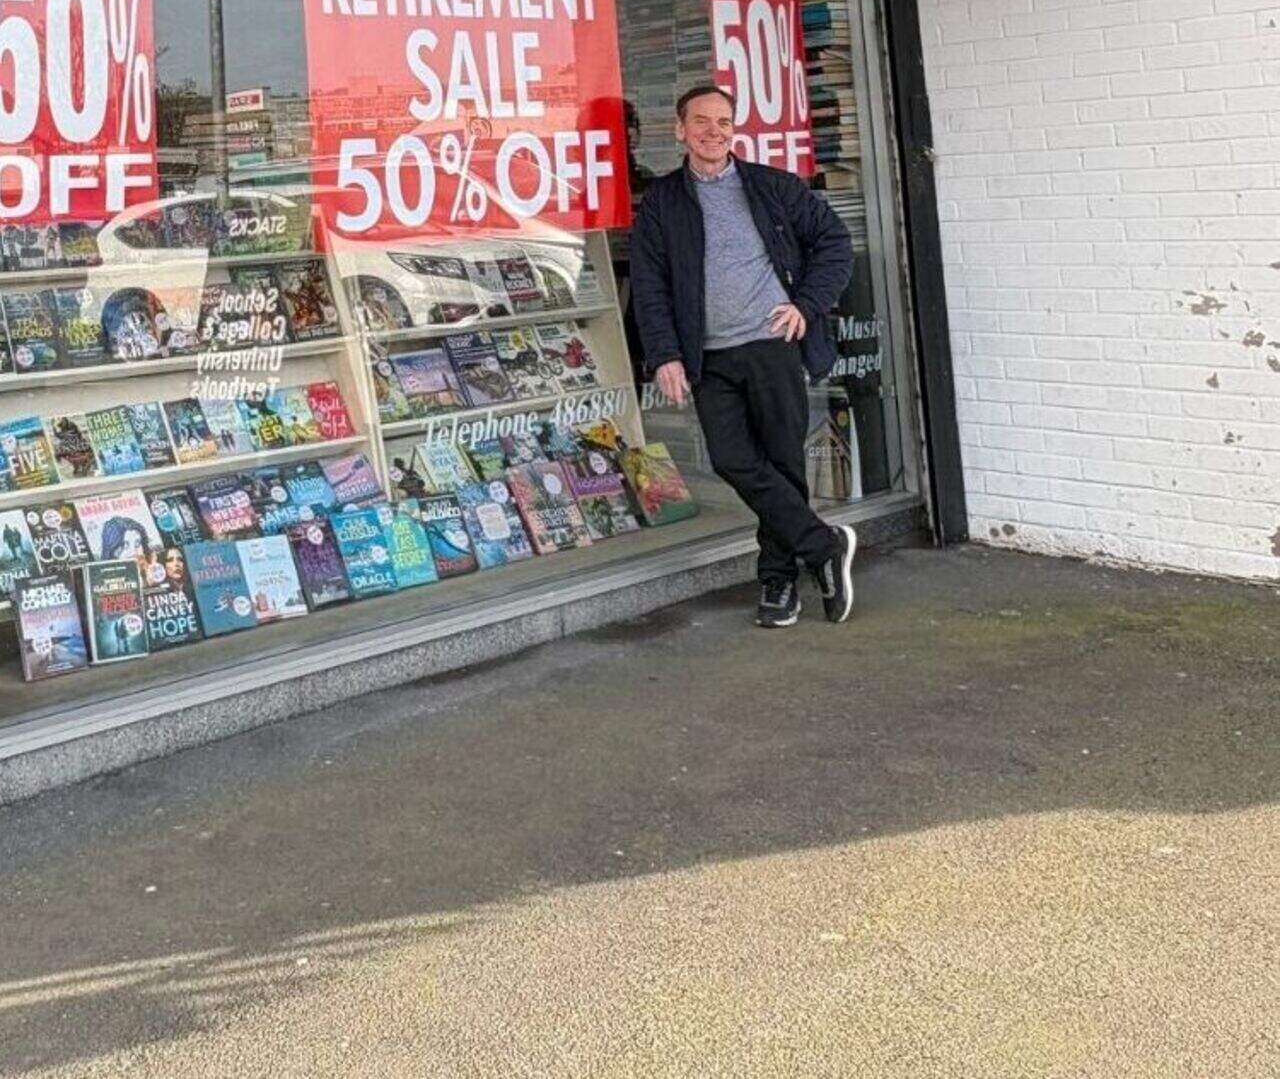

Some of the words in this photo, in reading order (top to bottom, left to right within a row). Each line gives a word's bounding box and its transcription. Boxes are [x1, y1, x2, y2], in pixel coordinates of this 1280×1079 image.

[406, 29, 546, 121] SALE
[336, 133, 488, 232] 50%
[496, 130, 613, 218] OFF
[838, 317, 882, 342] Music
[424, 410, 538, 448] Telephone
[552, 390, 628, 435] 486880
[150, 618, 198, 641] HOPE
